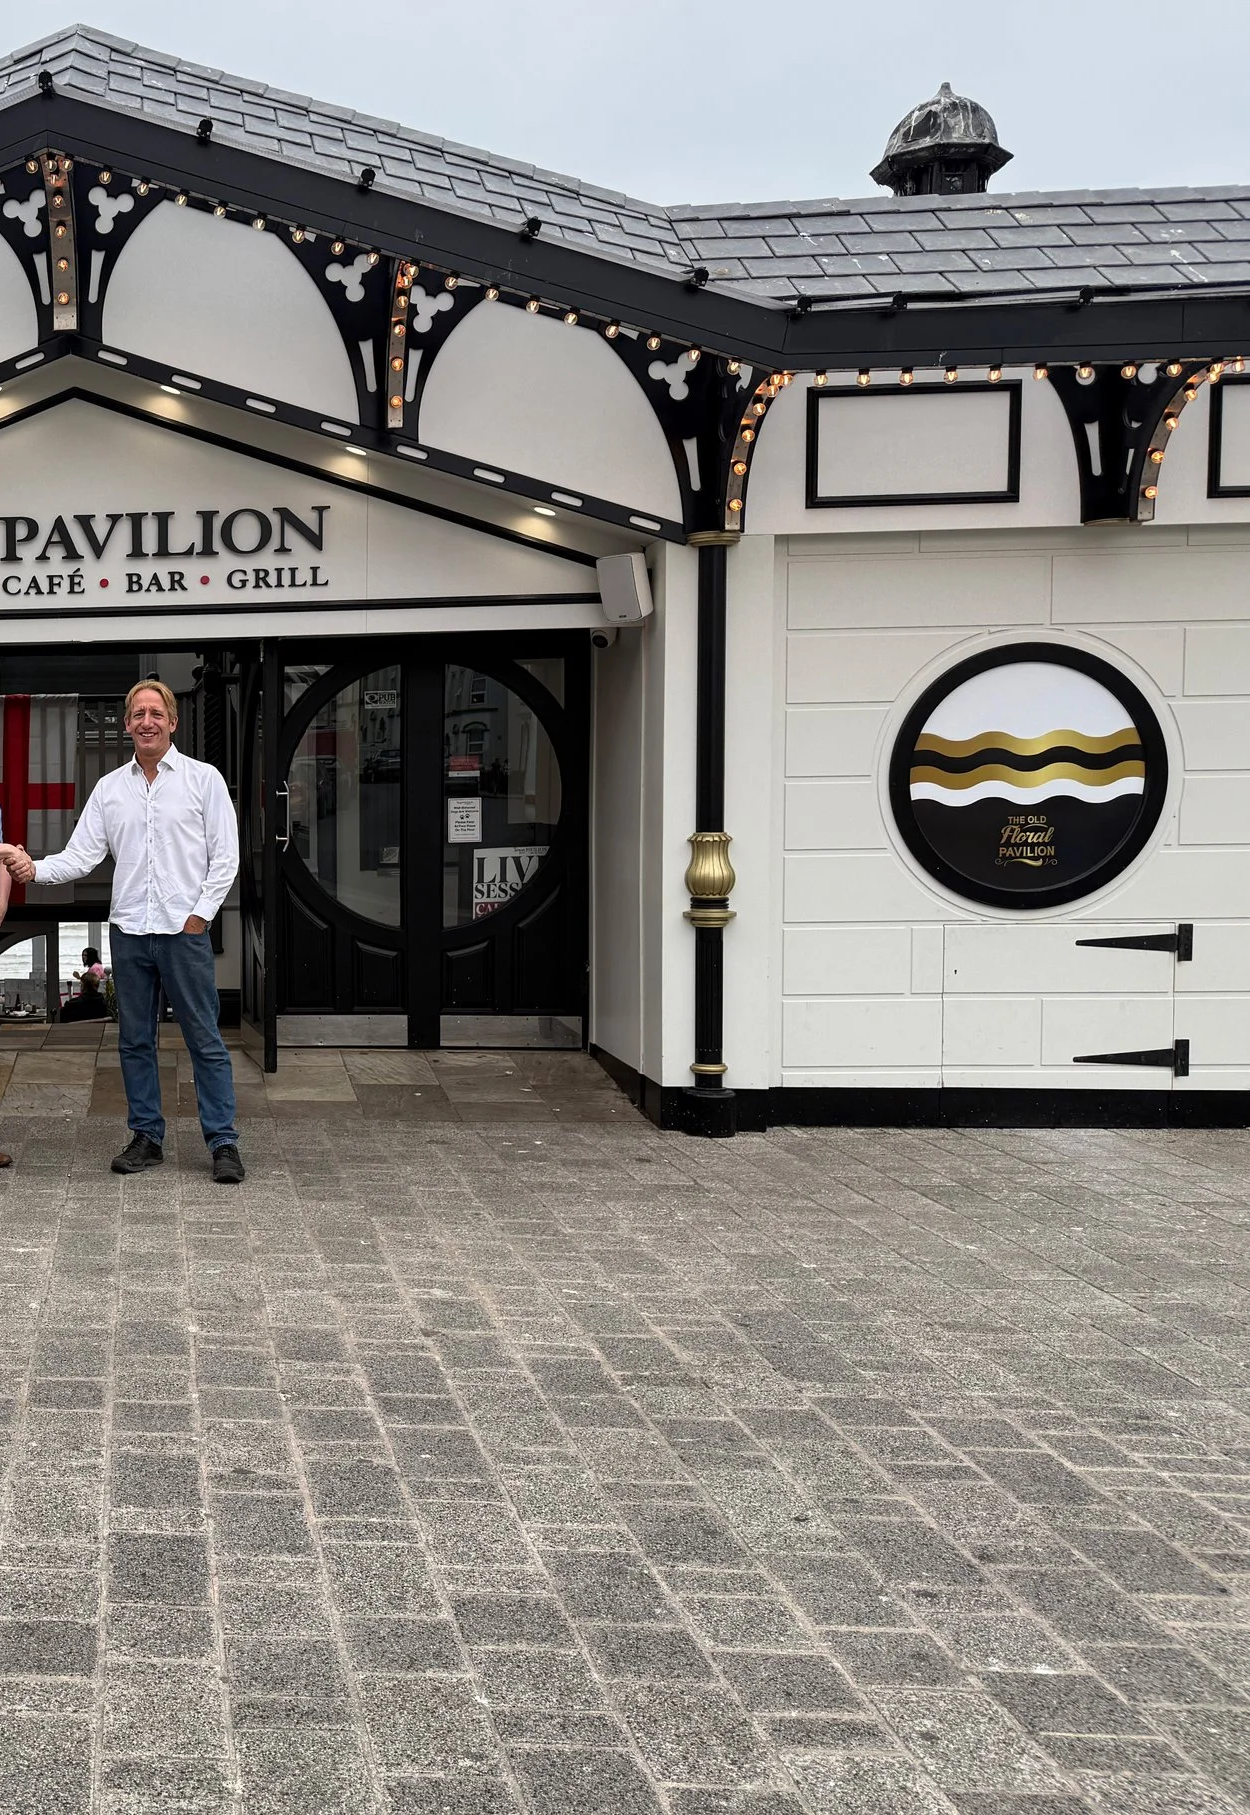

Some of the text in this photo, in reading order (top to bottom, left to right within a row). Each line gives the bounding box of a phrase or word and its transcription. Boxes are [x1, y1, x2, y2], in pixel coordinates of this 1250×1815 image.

[0, 505, 331, 562] PAVILION
[1, 566, 330, 596] CAFÉ BAR GRILL
[379, 694, 396, 702] PUB
[1008, 816, 1046, 824] THE OLD
[1000, 825, 1054, 844] Floral
[999, 846, 1055, 858] PAVILION
[475, 856, 541, 884] LIV
[474, 882, 522, 899] SESS
